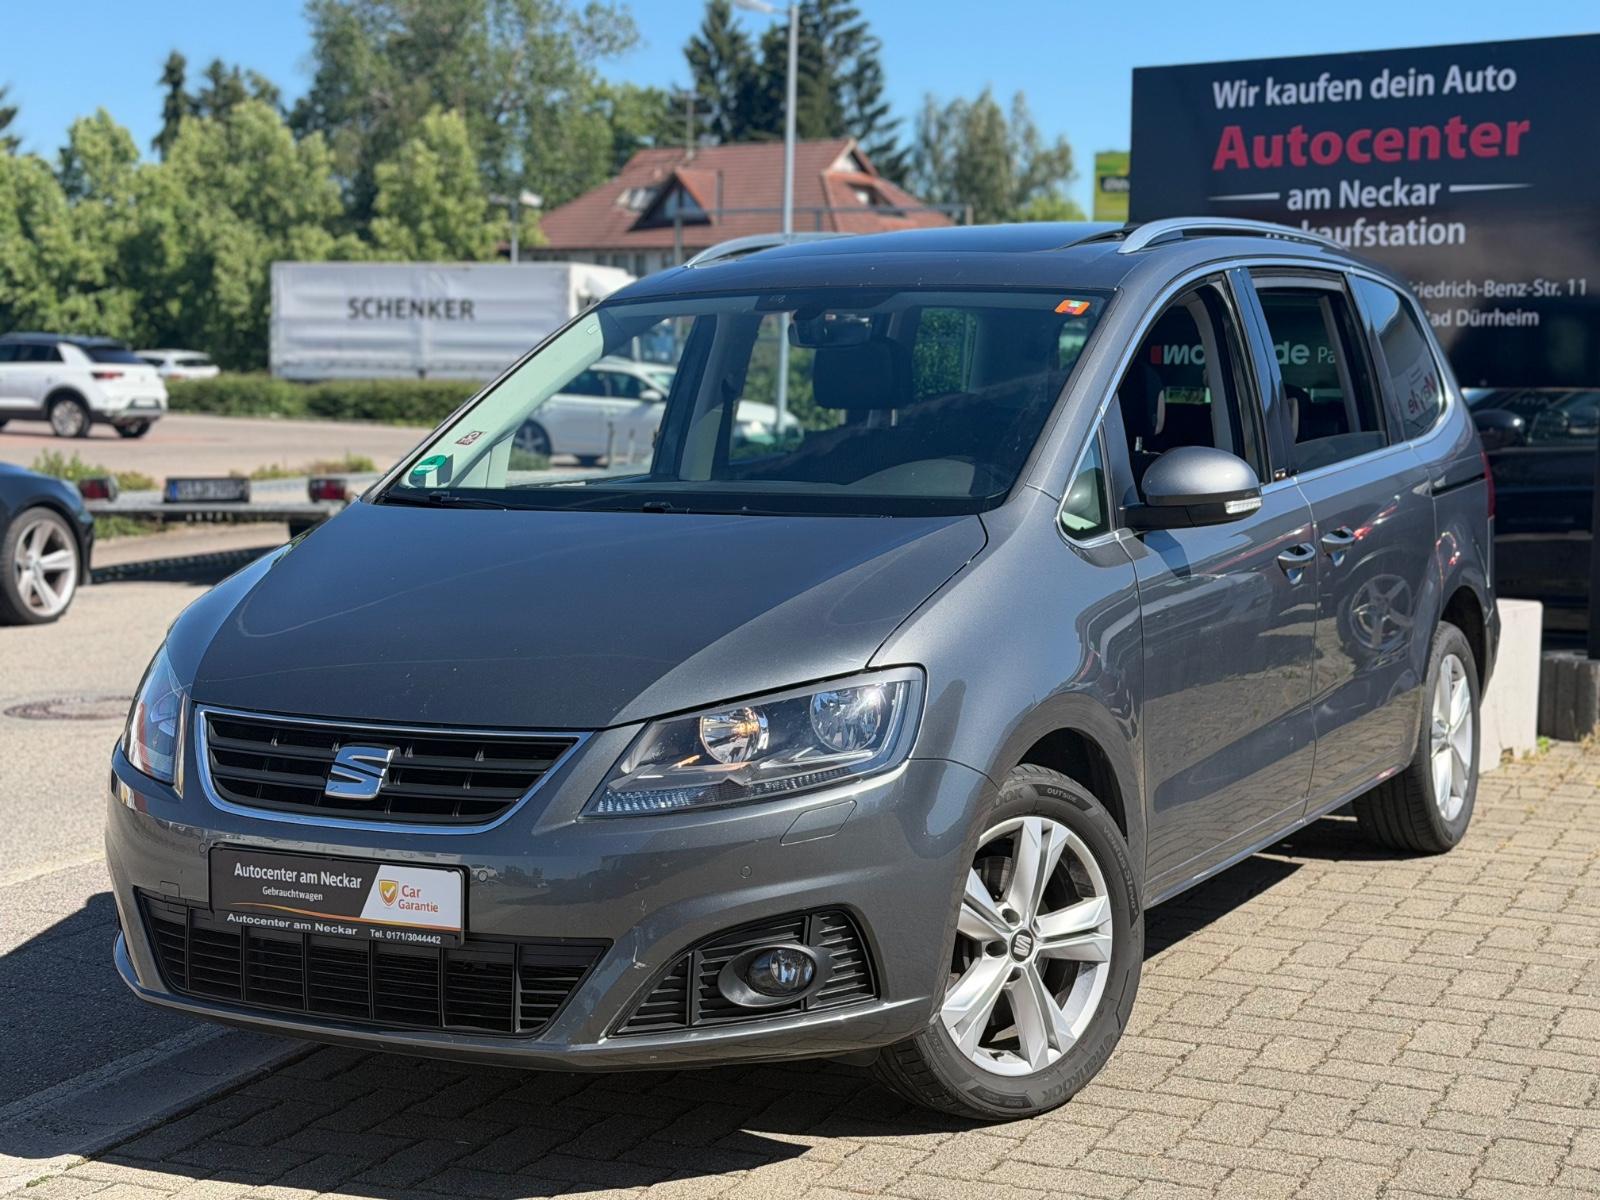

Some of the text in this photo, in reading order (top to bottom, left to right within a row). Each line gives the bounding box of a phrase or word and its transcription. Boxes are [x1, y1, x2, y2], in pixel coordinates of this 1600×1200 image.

[1212, 65, 1517, 109] Wir kaufen dein Auto
[1212, 115, 1531, 170] Autocenter
[1287, 177, 1441, 211] am Neckar
[1301, 217, 1466, 248] kaufstation
[1409, 278, 1587, 298] riedrich-Benz-Str. 11
[347, 296, 476, 320] SCHENKER
[1425, 308, 1540, 327] ad Dürrheim
[234, 862, 362, 889] Autocenter am Neckar
[262, 886, 323, 902] Gebrauchtwagen
[401, 885, 422, 898] Car
[398, 899, 439, 913] Garantie
[227, 913, 291, 928] Autocenter
[293, 921, 311, 931] am
[314, 923, 358, 936] Neckar
[370, 928, 385, 939] Tel.
